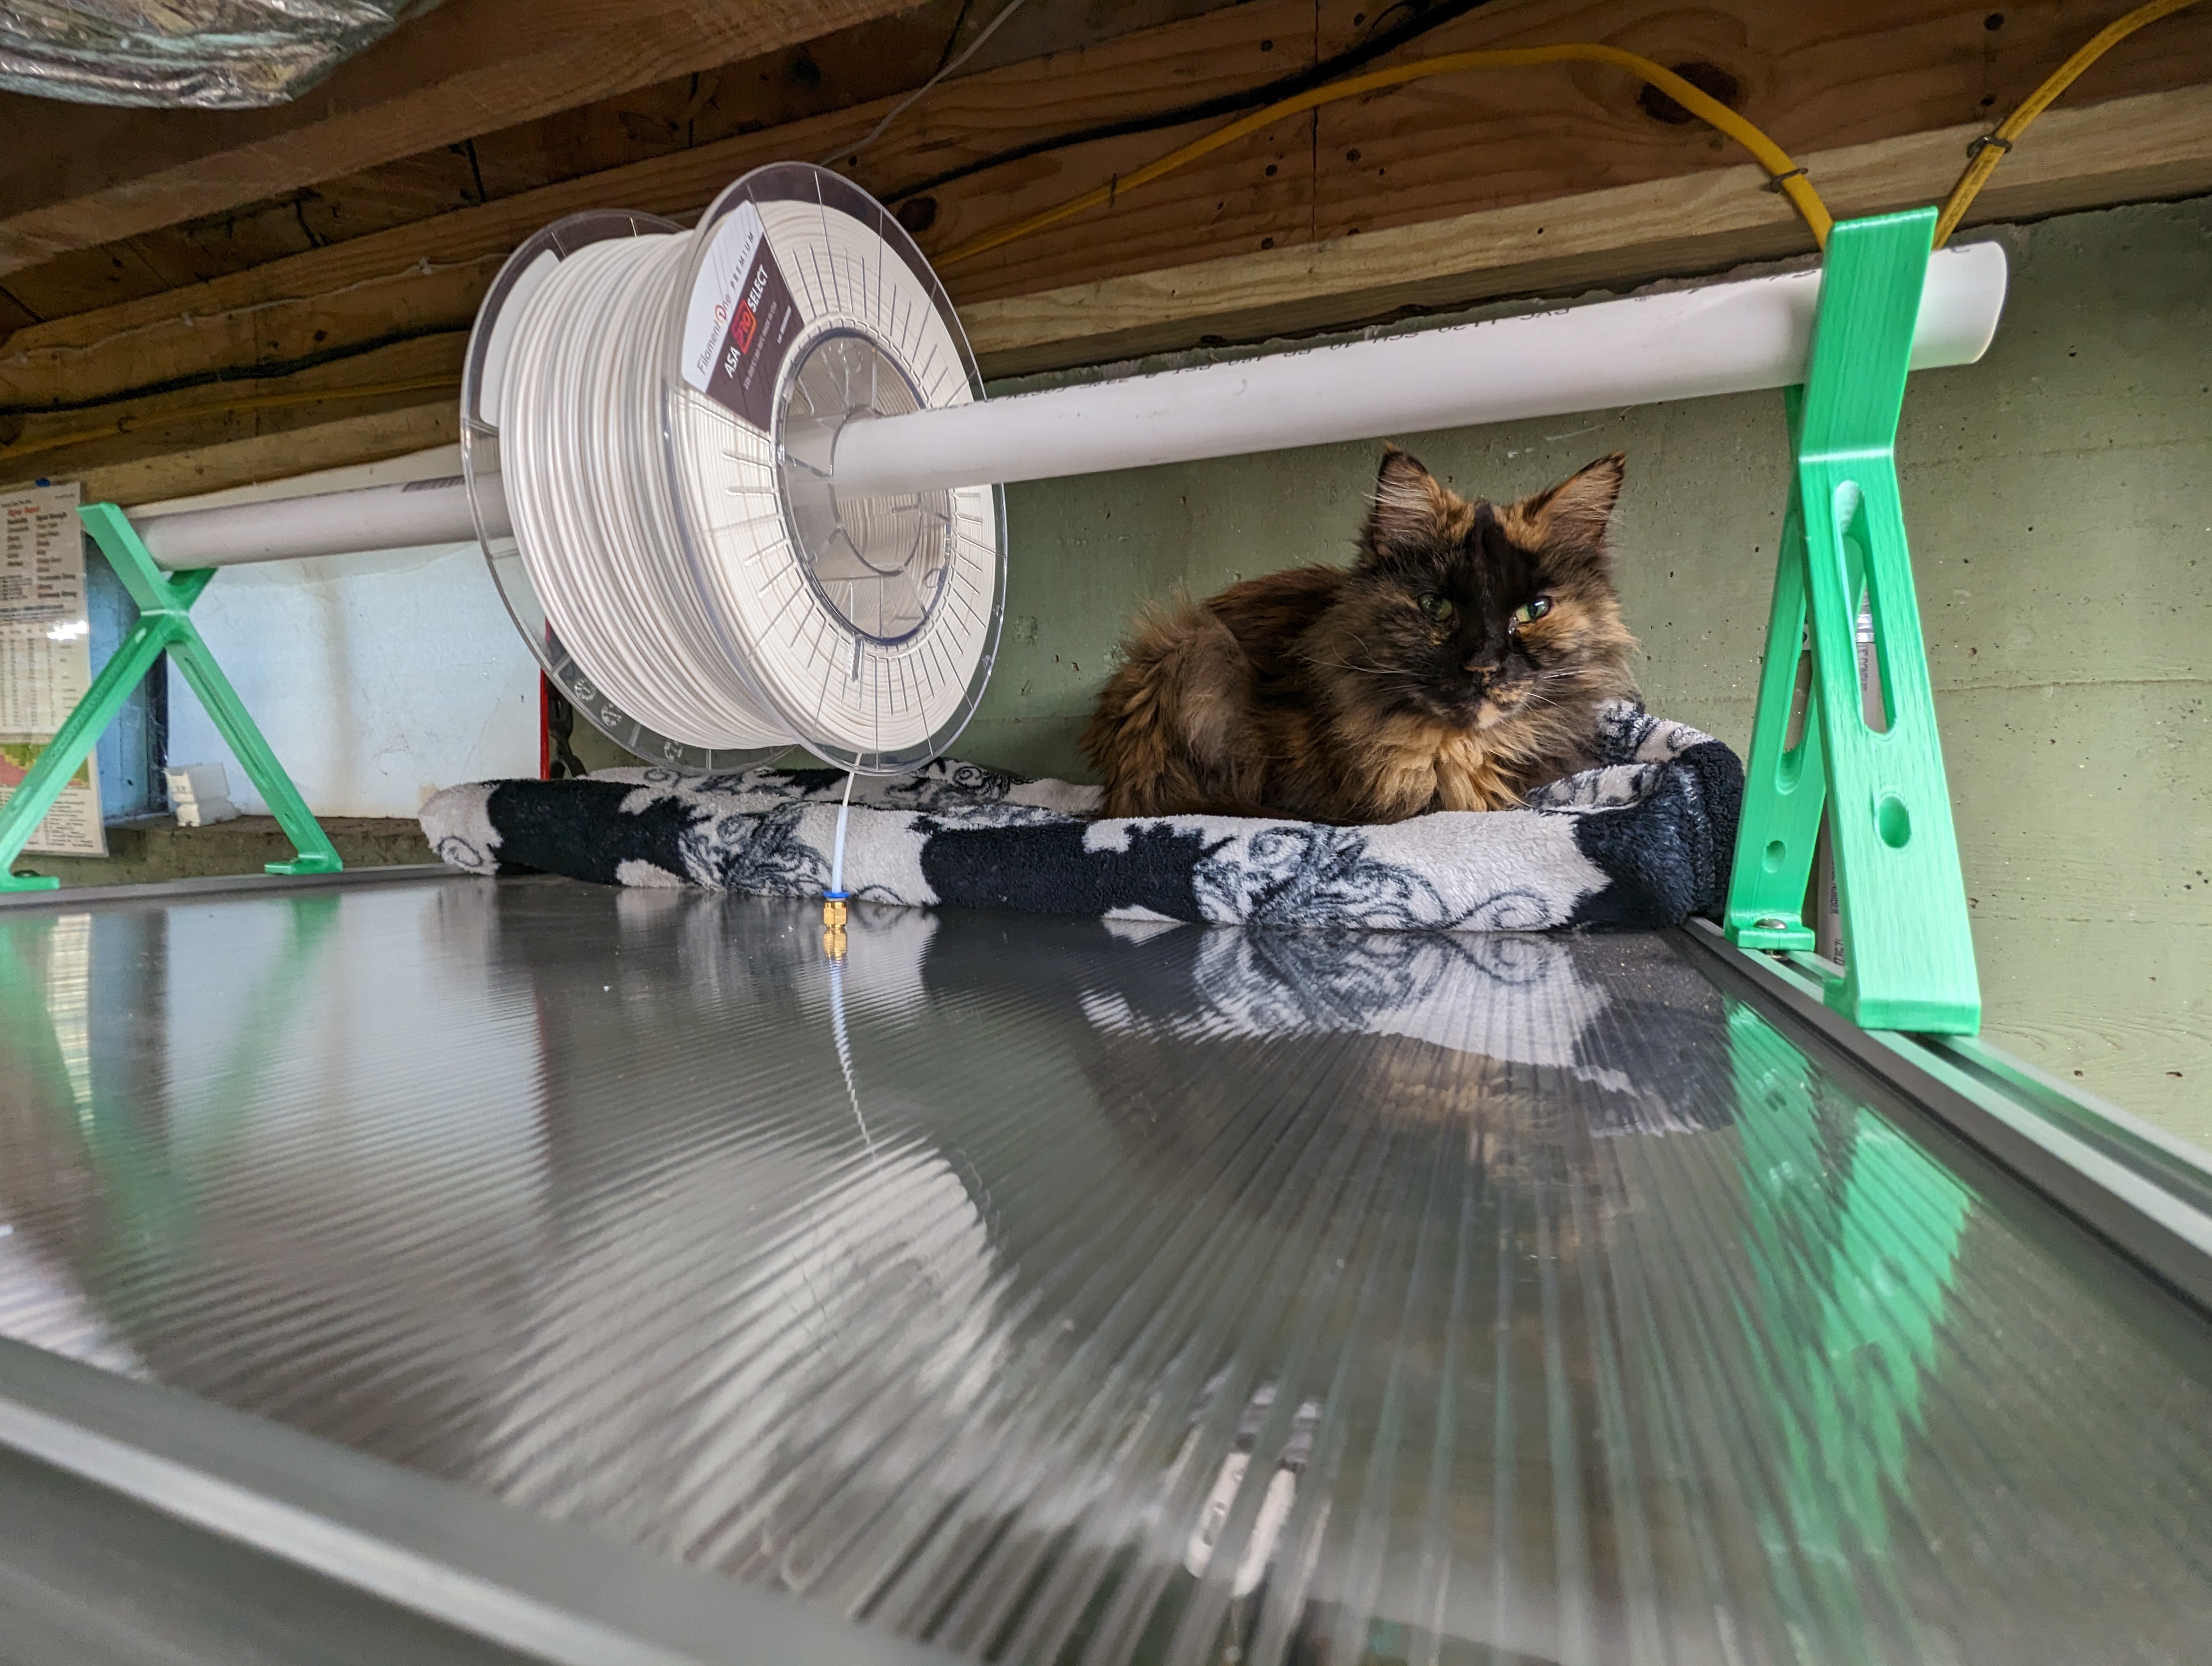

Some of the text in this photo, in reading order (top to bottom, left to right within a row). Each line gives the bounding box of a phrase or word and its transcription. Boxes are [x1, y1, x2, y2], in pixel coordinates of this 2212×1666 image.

[730, 232, 754, 290] PREMIUM
[724, 347, 741, 379] ASA
[748, 264, 768, 312] SELECT
